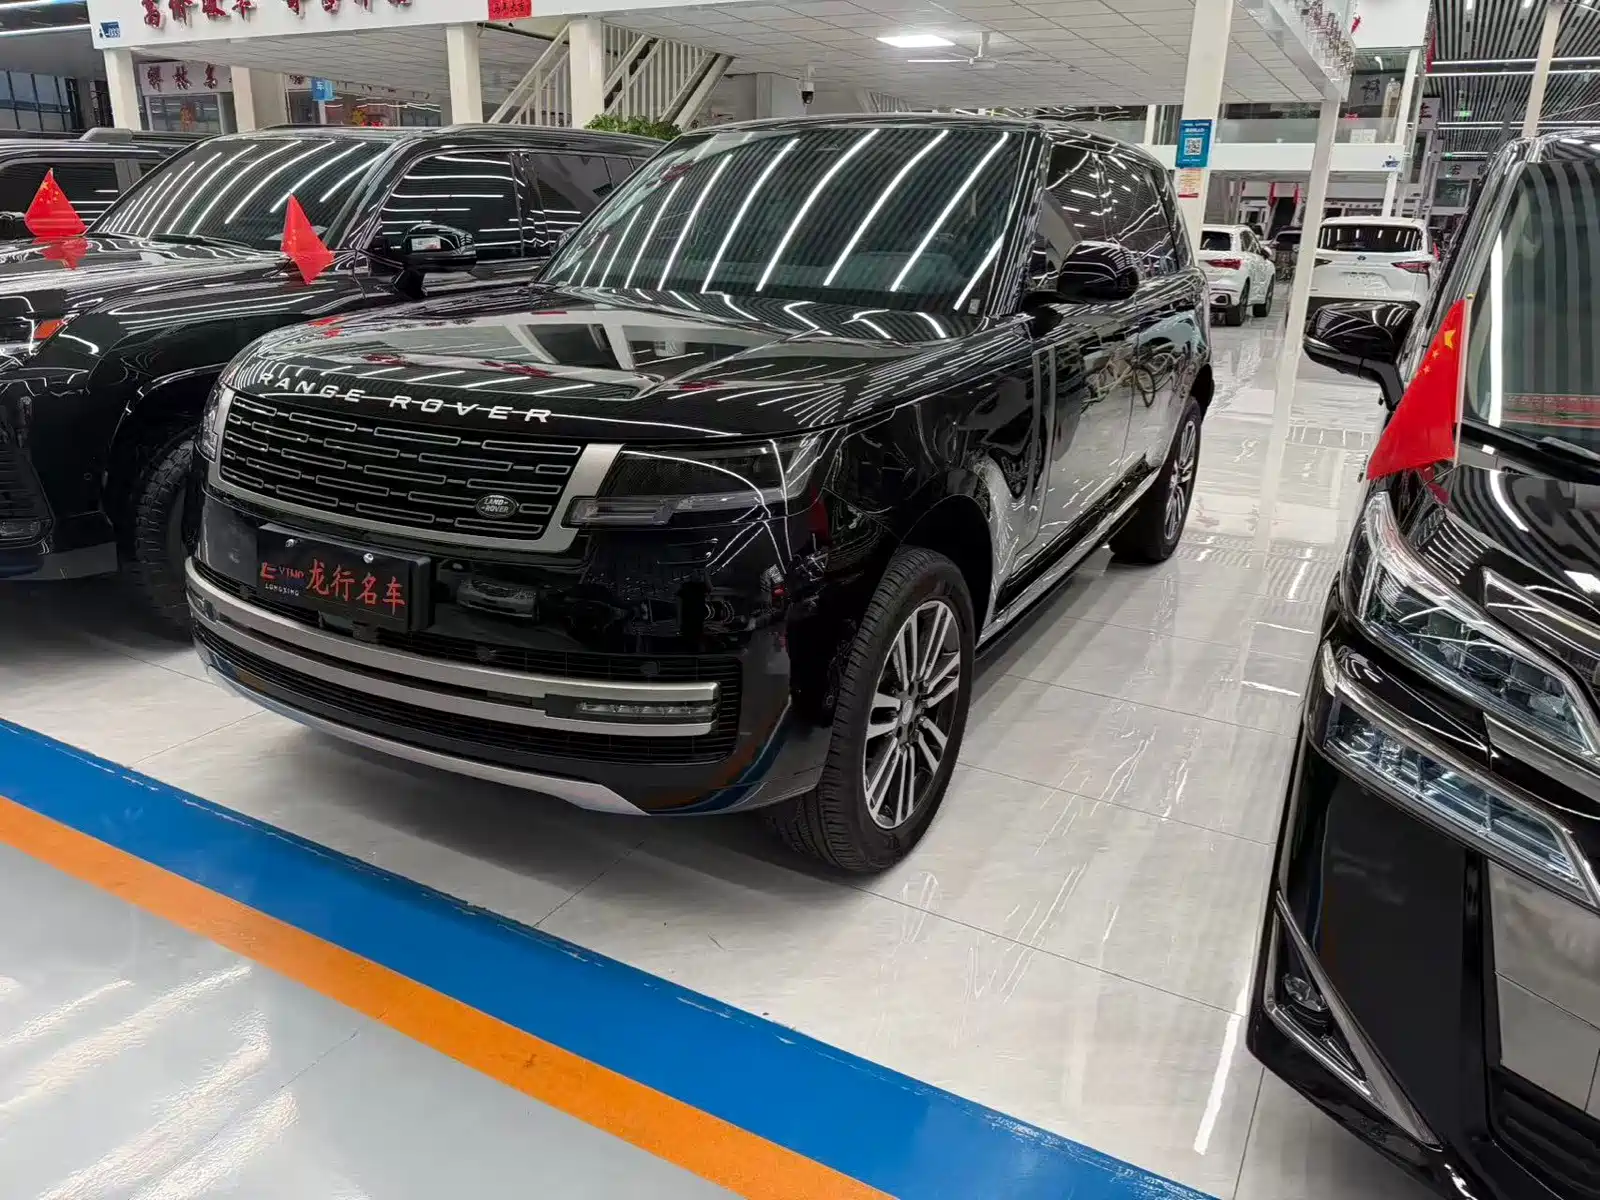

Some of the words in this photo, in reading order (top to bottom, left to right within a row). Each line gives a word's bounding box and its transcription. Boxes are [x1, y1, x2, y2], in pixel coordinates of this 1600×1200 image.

[257, 371, 366, 402] RANGE
[389, 394, 552, 423] ROVER
[484, 505, 509, 514] ROVER
[305, 558, 406, 616] 龙行名车
